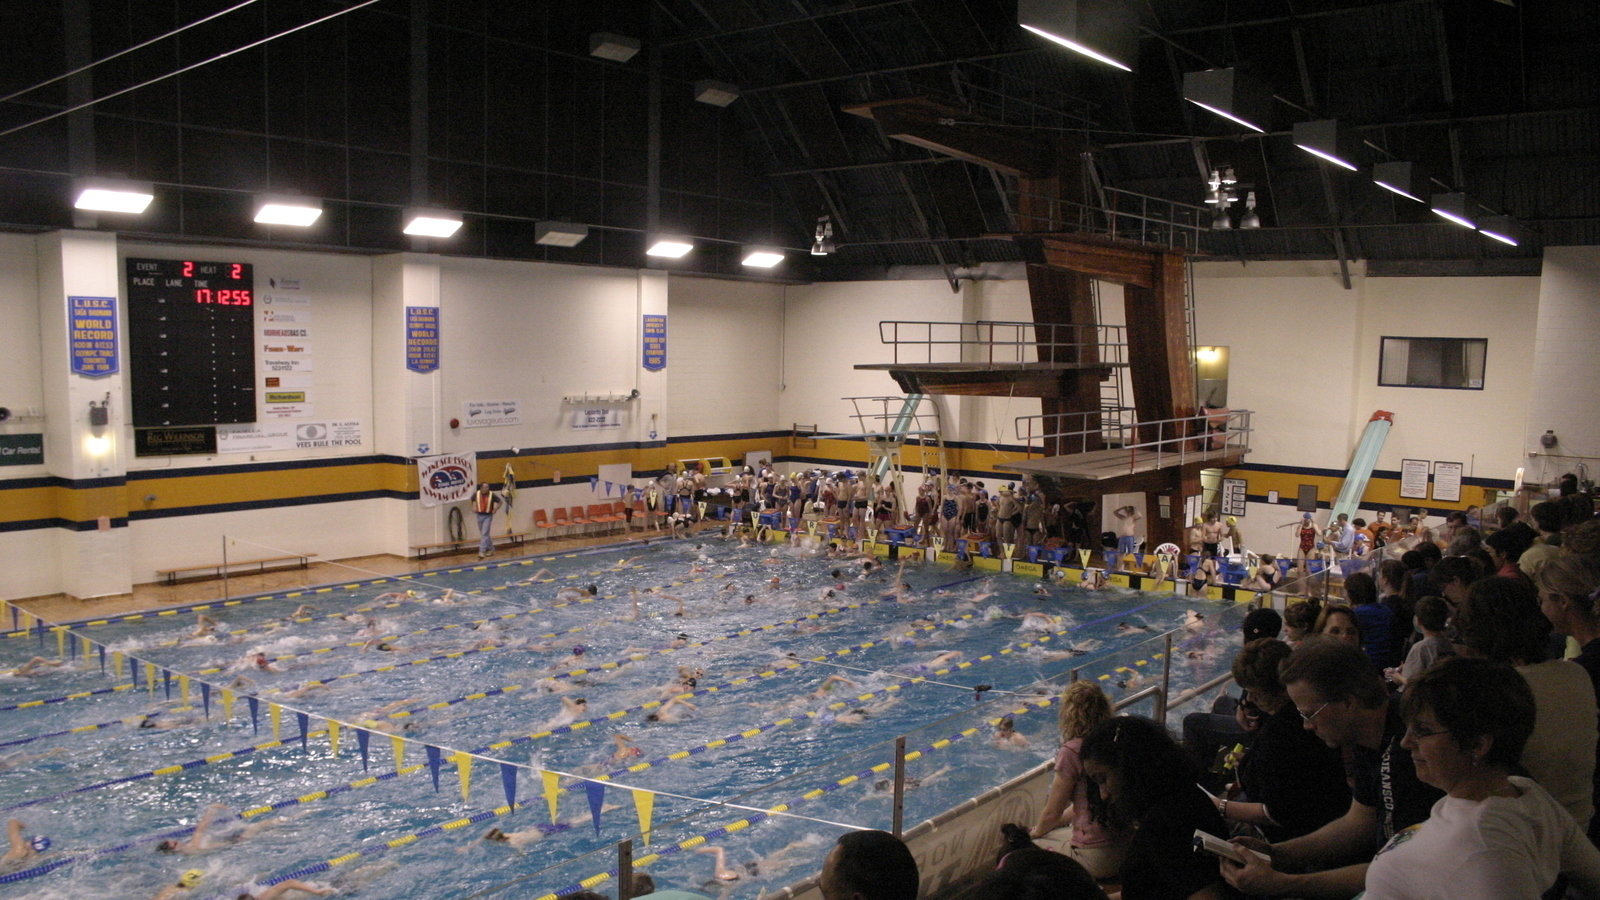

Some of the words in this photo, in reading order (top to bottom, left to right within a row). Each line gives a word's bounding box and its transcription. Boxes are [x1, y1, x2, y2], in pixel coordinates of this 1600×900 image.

[137, 263, 158, 271] EVENT
[183, 261, 193, 277] 2
[201, 266, 216, 274] HEAT
[232, 264, 242, 279] 2
[133, 278, 155, 286] PLACE
[194, 280, 208, 288] TIME
[75, 320, 112, 329] WORLD
[74, 330, 113, 340] RECORD
